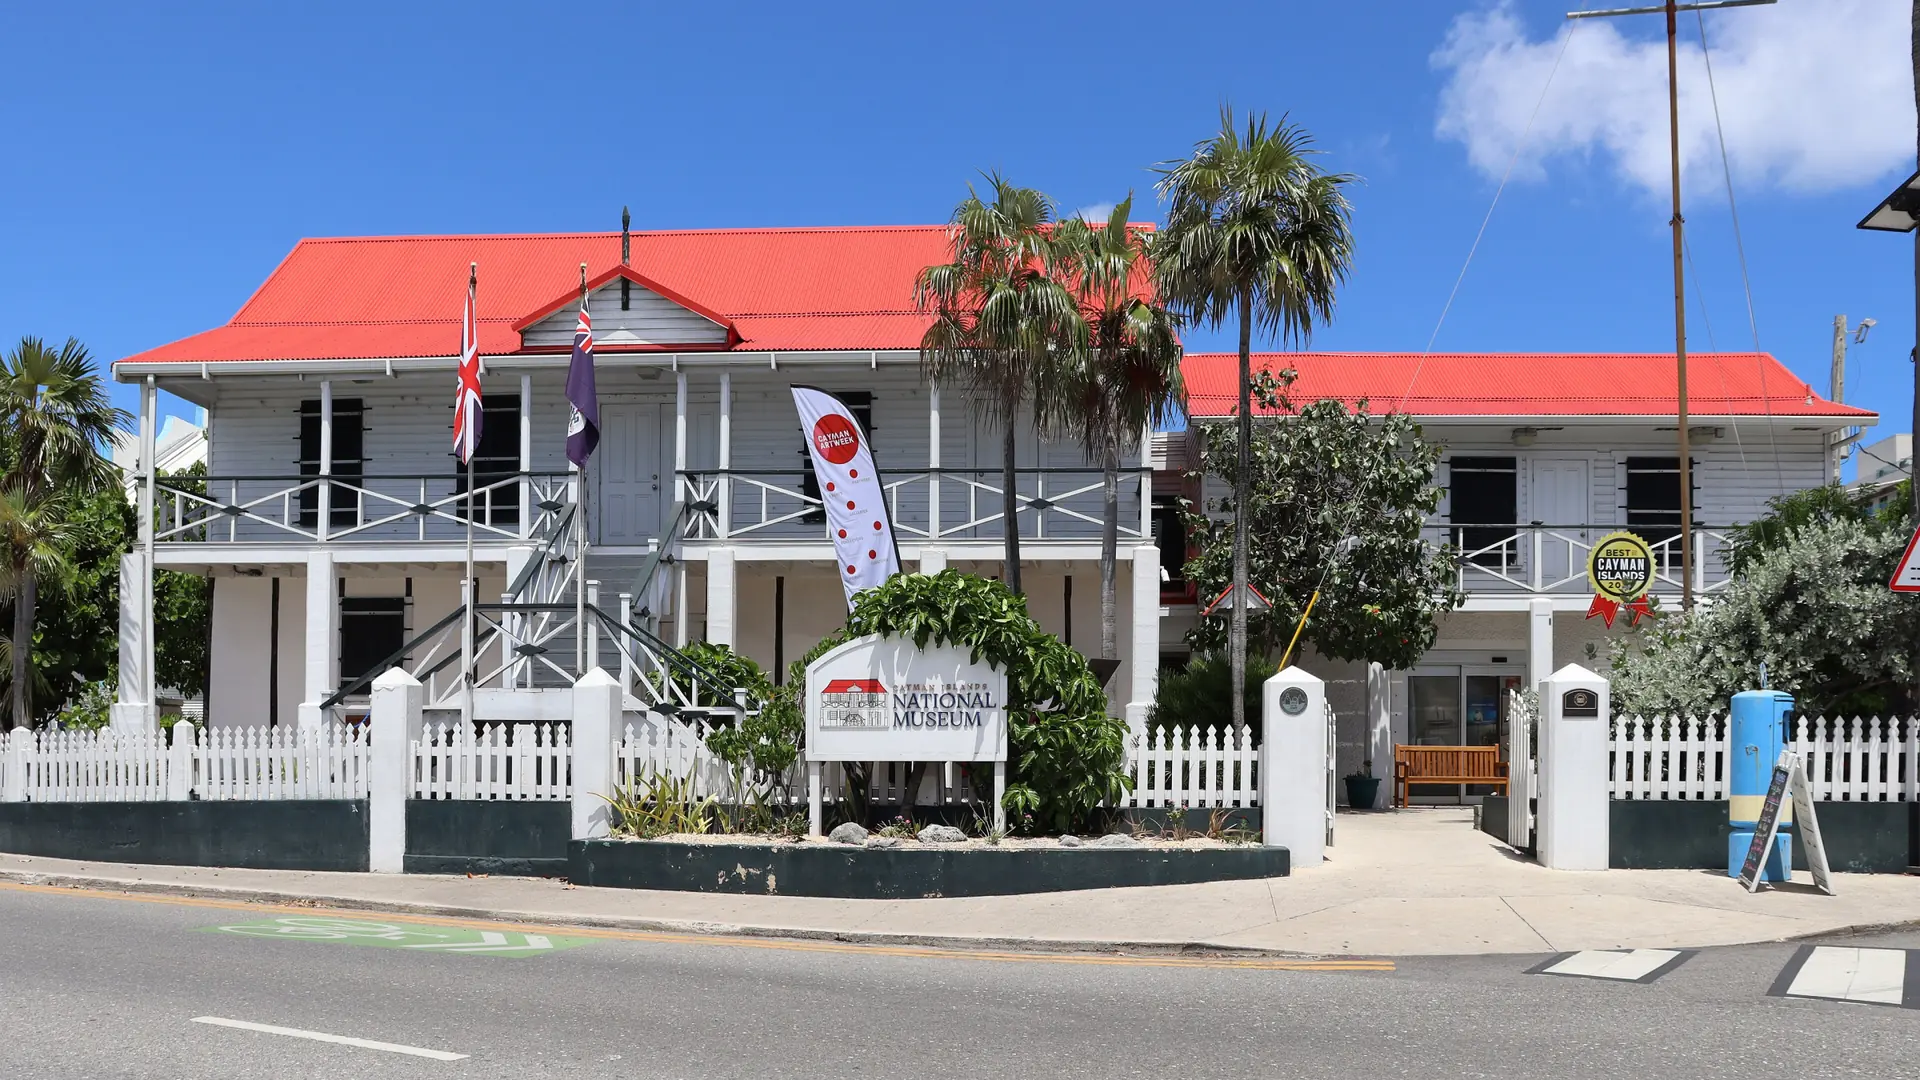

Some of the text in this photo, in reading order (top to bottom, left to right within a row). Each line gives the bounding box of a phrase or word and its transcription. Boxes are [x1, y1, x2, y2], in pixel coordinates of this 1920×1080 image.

[817, 430, 850, 443] CAYMAN
[820, 436, 855, 450] ARTWEEK
[1605, 549, 1631, 557] BEST
[1597, 558, 1645, 571] CAYMAN
[1597, 571, 1645, 580] ISLANDS
[892, 683, 988, 692] CAYMAN ISLANDS
[893, 692, 997, 709] NATIONAL
[892, 711, 982, 727] MUSEUM
